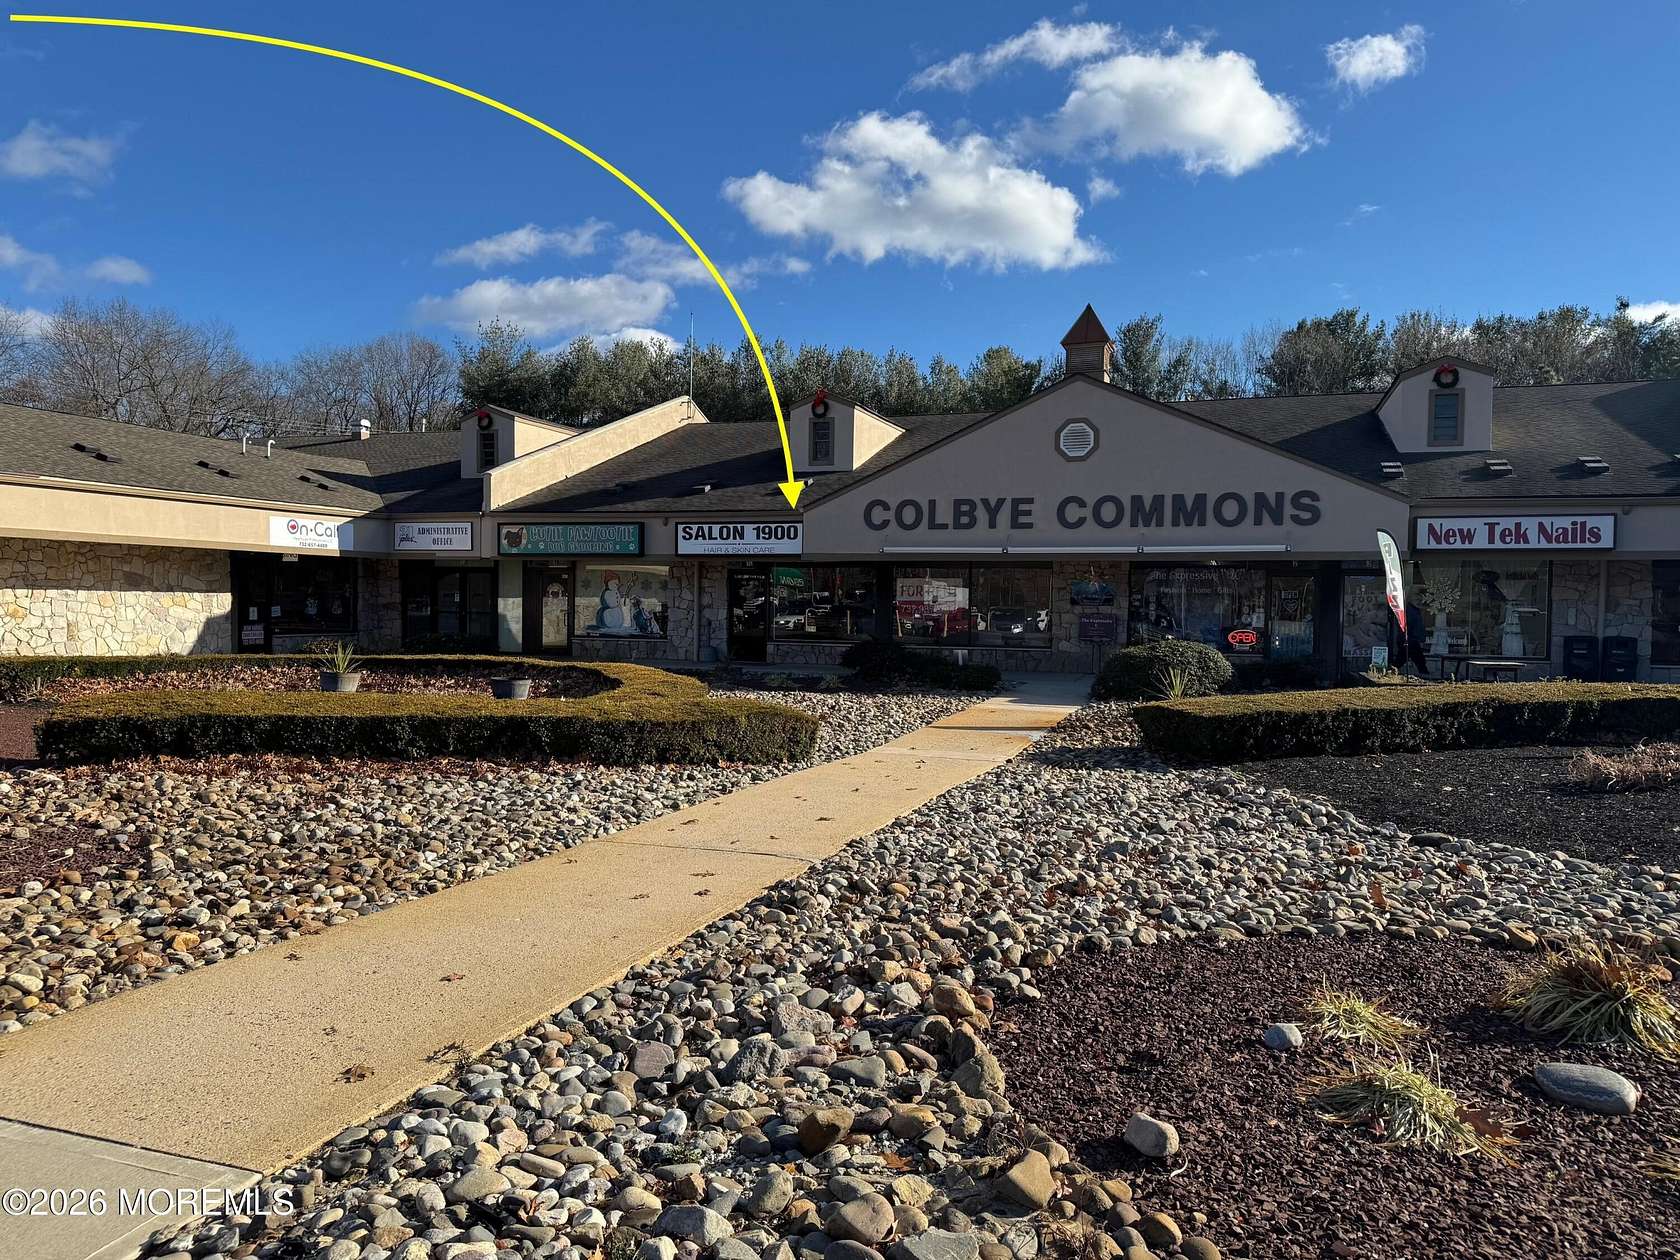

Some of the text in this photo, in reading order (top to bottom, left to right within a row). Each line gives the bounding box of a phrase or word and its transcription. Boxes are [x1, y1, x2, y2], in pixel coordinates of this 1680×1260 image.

[863, 489, 1322, 531] COLBYE COMMONS
[417, 526, 469, 535] ADMINISTRATIVE
[681, 524, 799, 541] SALON 1900
[1426, 520, 1602, 545] New Tek Nails
[432, 537, 453, 546] OFFICE
[900, 584, 924, 597] FOR
[1230, 632, 1256, 643] OPEN
